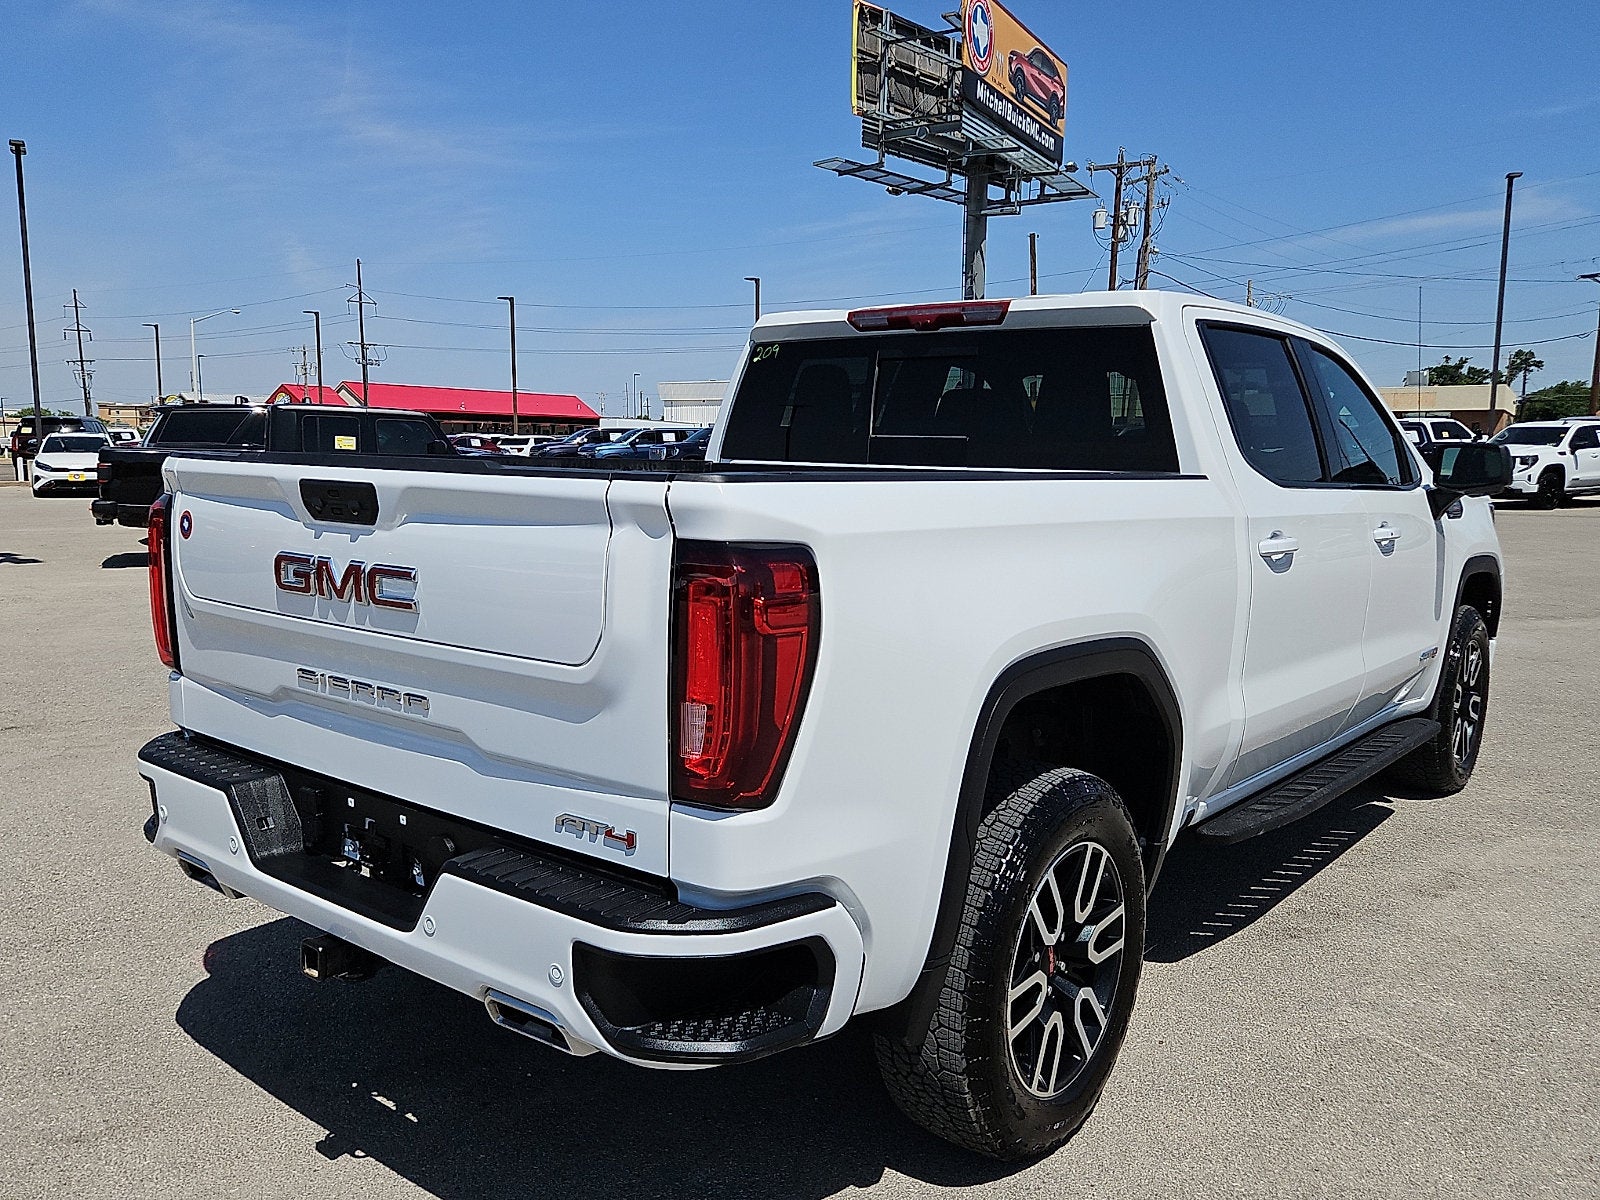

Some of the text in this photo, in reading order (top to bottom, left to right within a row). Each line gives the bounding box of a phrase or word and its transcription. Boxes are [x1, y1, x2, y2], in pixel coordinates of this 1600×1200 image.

[976, 80, 1055, 152] MitchellBuickGMC.com
[753, 344, 780, 363] 209
[274, 550, 420, 614] GMC
[297, 667, 430, 713] SIERRA
[555, 813, 637, 851] AT4
